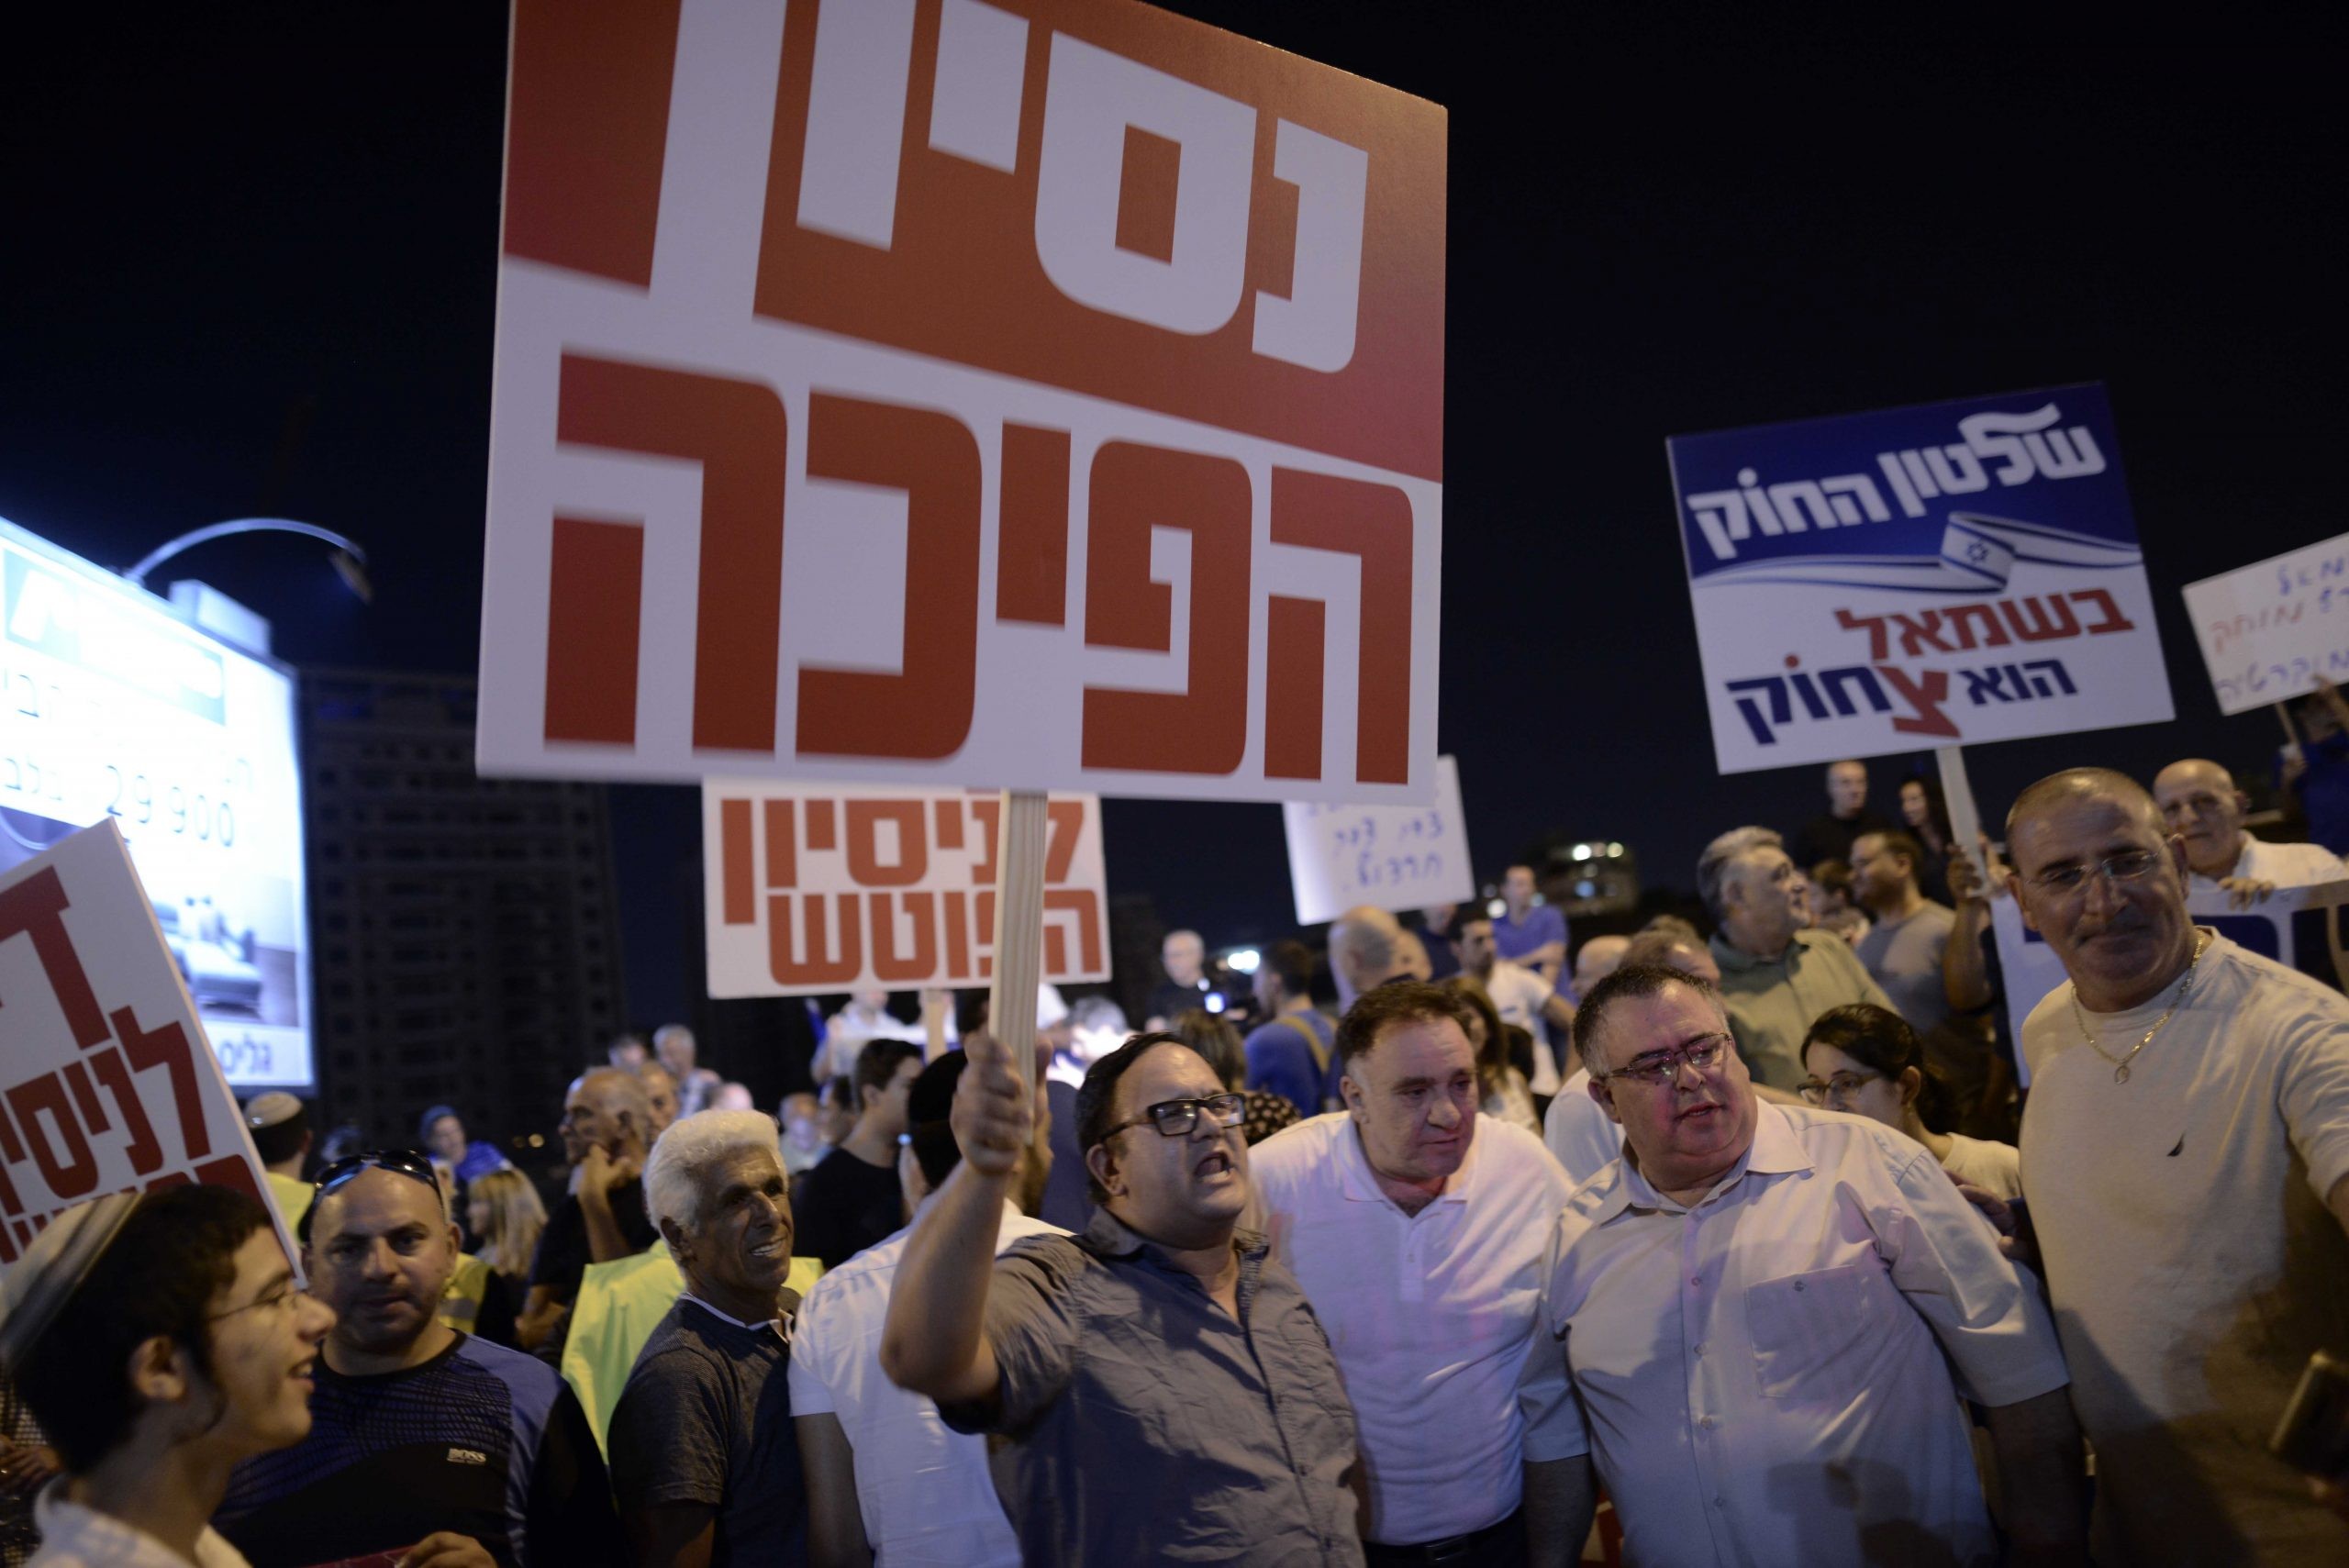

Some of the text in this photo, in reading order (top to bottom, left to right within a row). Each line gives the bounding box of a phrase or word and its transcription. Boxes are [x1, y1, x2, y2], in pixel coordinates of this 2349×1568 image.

[650, 0, 1369, 374] נסיון
[1876, 403, 2107, 518] שלטון
[543, 339, 1414, 787] הפיכה
[1834, 587, 2136, 667] בשמאל
[1954, 658, 2079, 706] הוא
